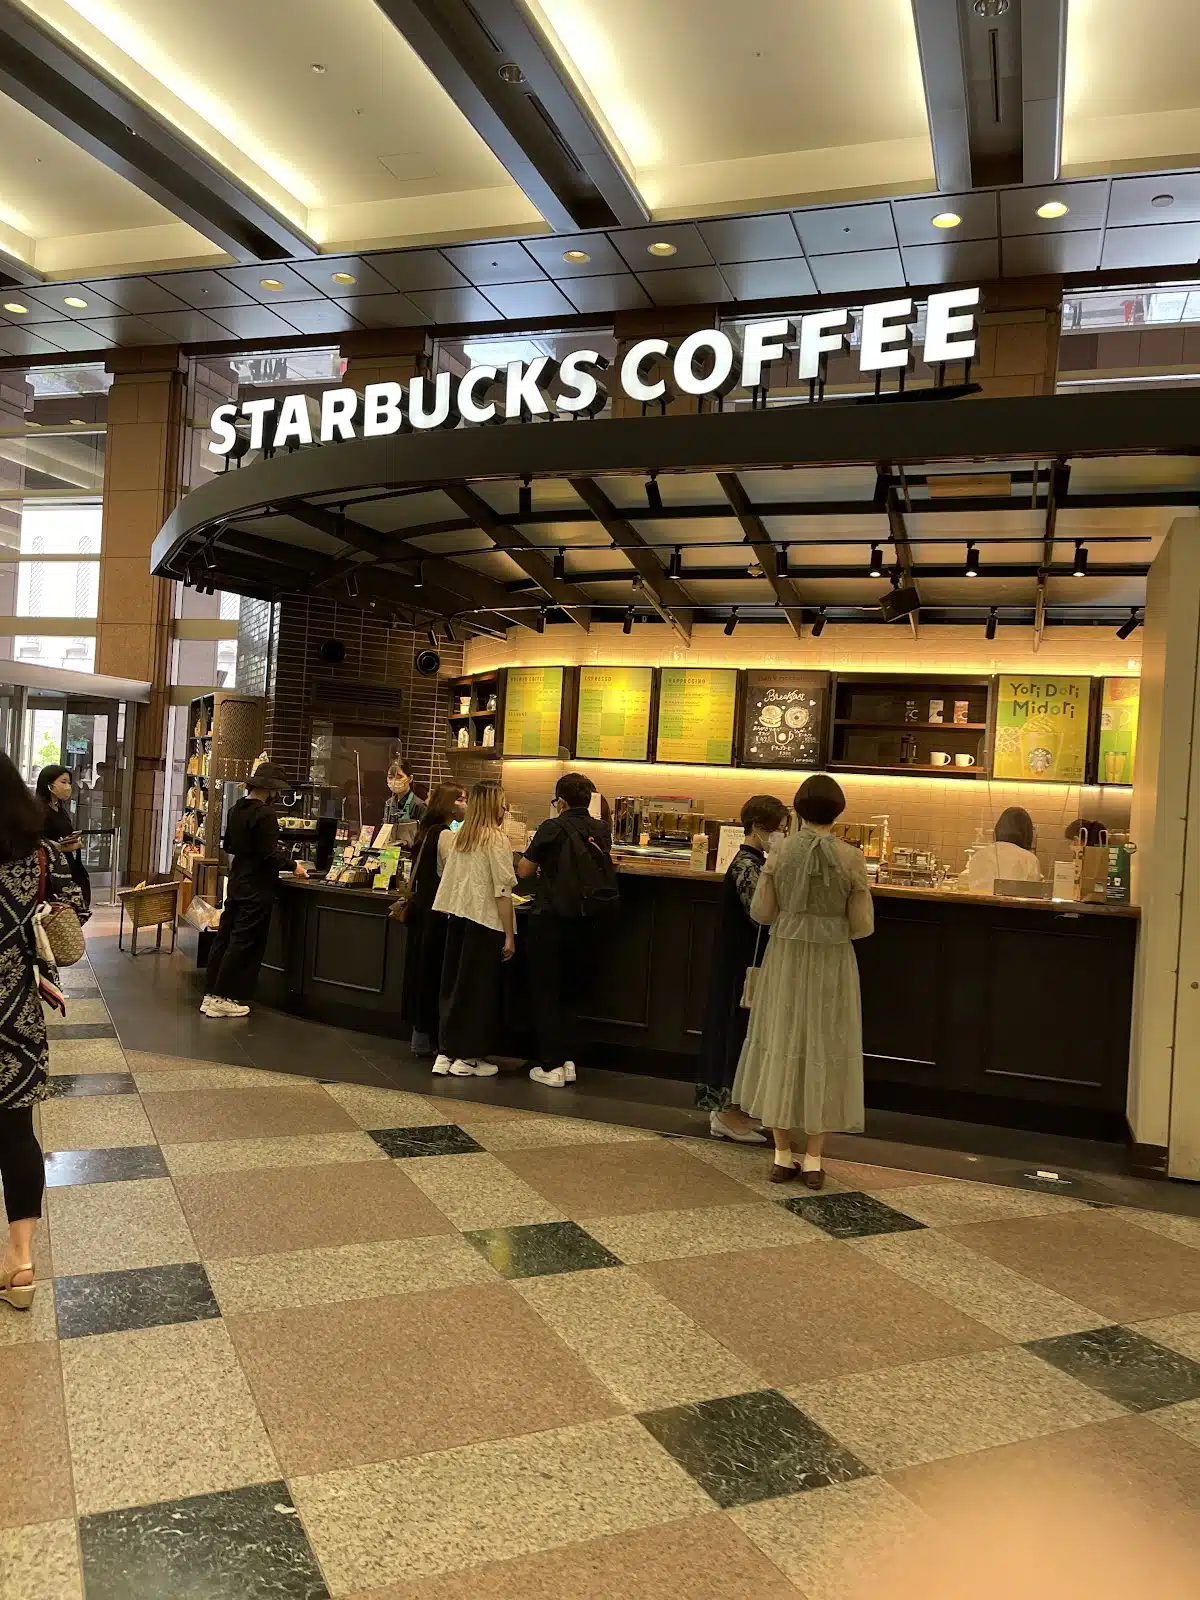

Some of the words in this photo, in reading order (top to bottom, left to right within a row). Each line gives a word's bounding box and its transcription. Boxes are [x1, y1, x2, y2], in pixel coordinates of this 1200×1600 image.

[208, 341, 600, 456] STARBUCKS
[621, 287, 980, 402] COFFEE
[763, 688, 806, 703] Breakfast
[1010, 682, 1041, 698] Yori
[1045, 683, 1080, 699] Dori
[1012, 699, 1075, 719] Midori
